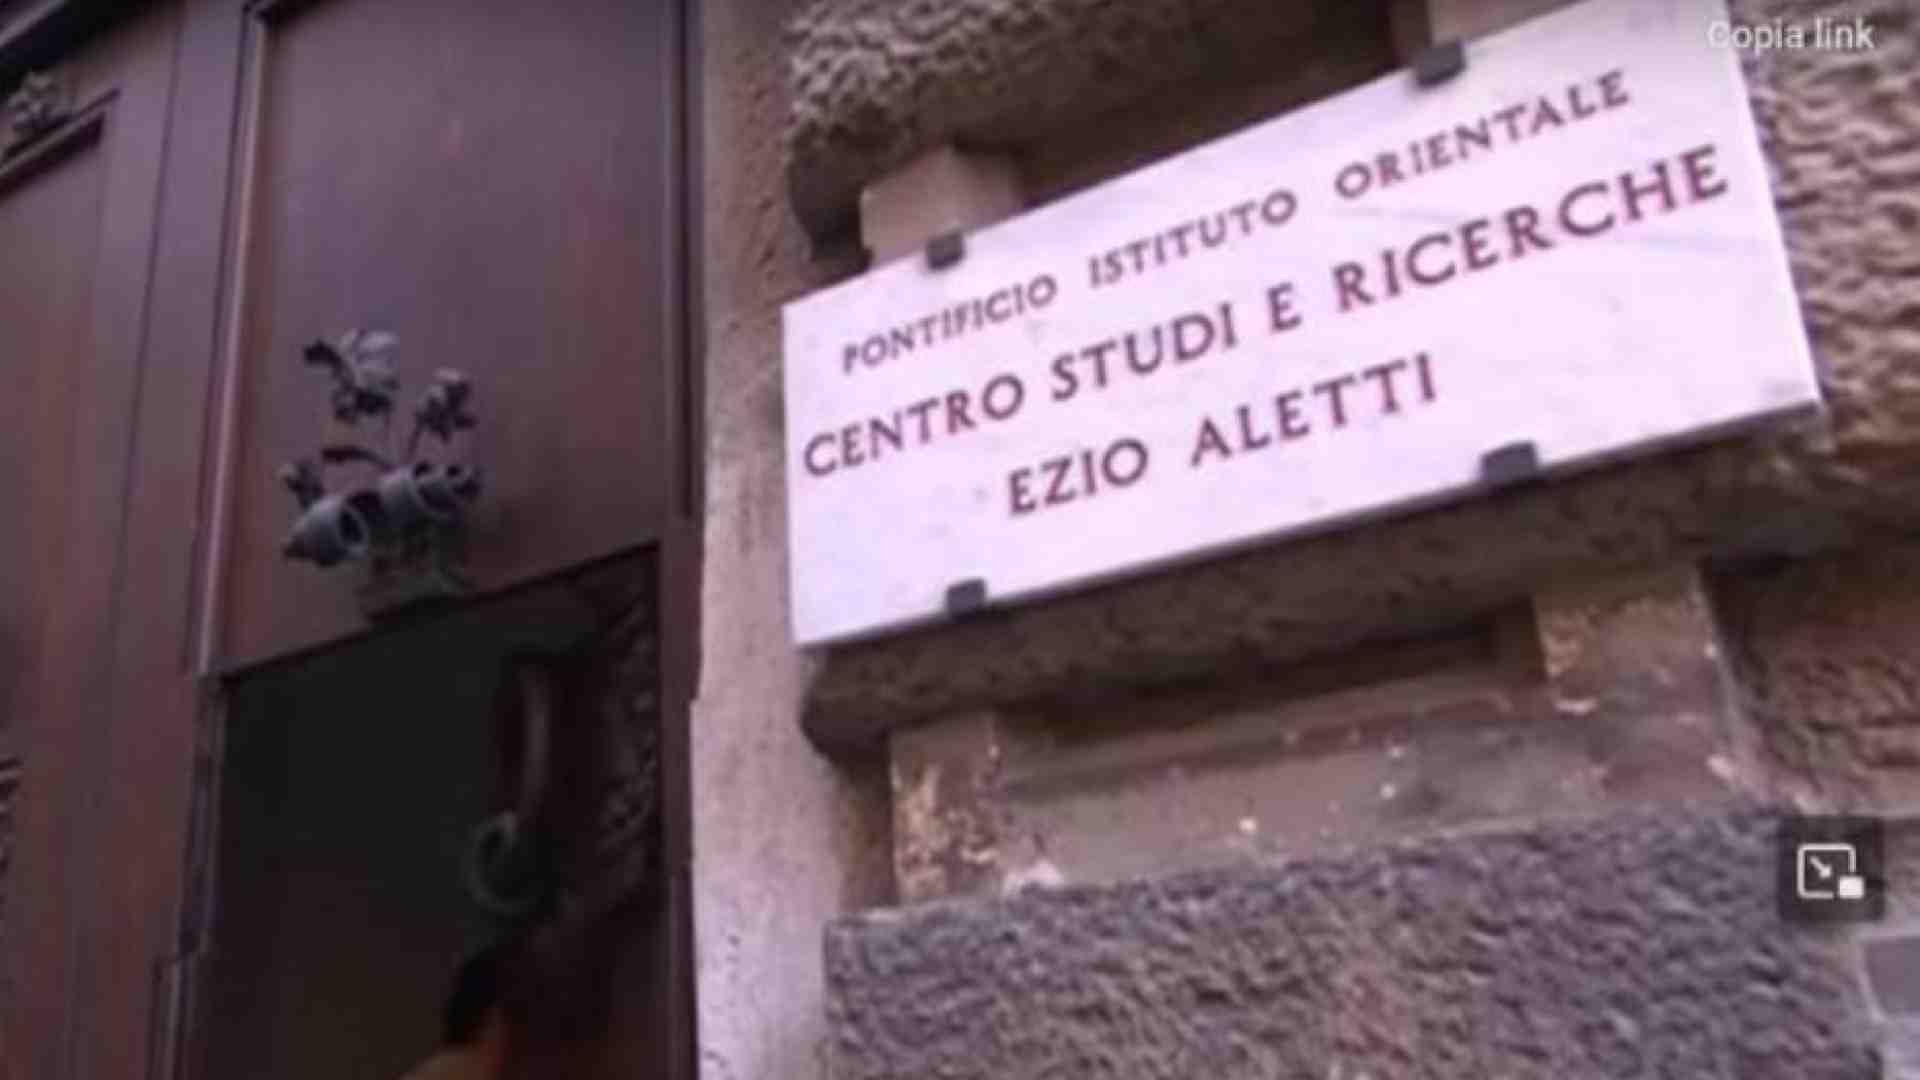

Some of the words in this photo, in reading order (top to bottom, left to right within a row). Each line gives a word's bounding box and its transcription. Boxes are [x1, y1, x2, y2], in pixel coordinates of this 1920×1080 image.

[803, 374, 1024, 477] CENTRO
[1050, 303, 1238, 402] STUDI
[1267, 283, 1302, 333] E
[1331, 144, 1728, 311] RICERCHE
[842, 274, 1058, 374] PONTIFICIO
[1088, 190, 1298, 288] ISTITUTO
[1333, 69, 1630, 200] ORIENTALE
[1008, 438, 1149, 516] EZIO
[1190, 353, 1437, 466] ALETTI
